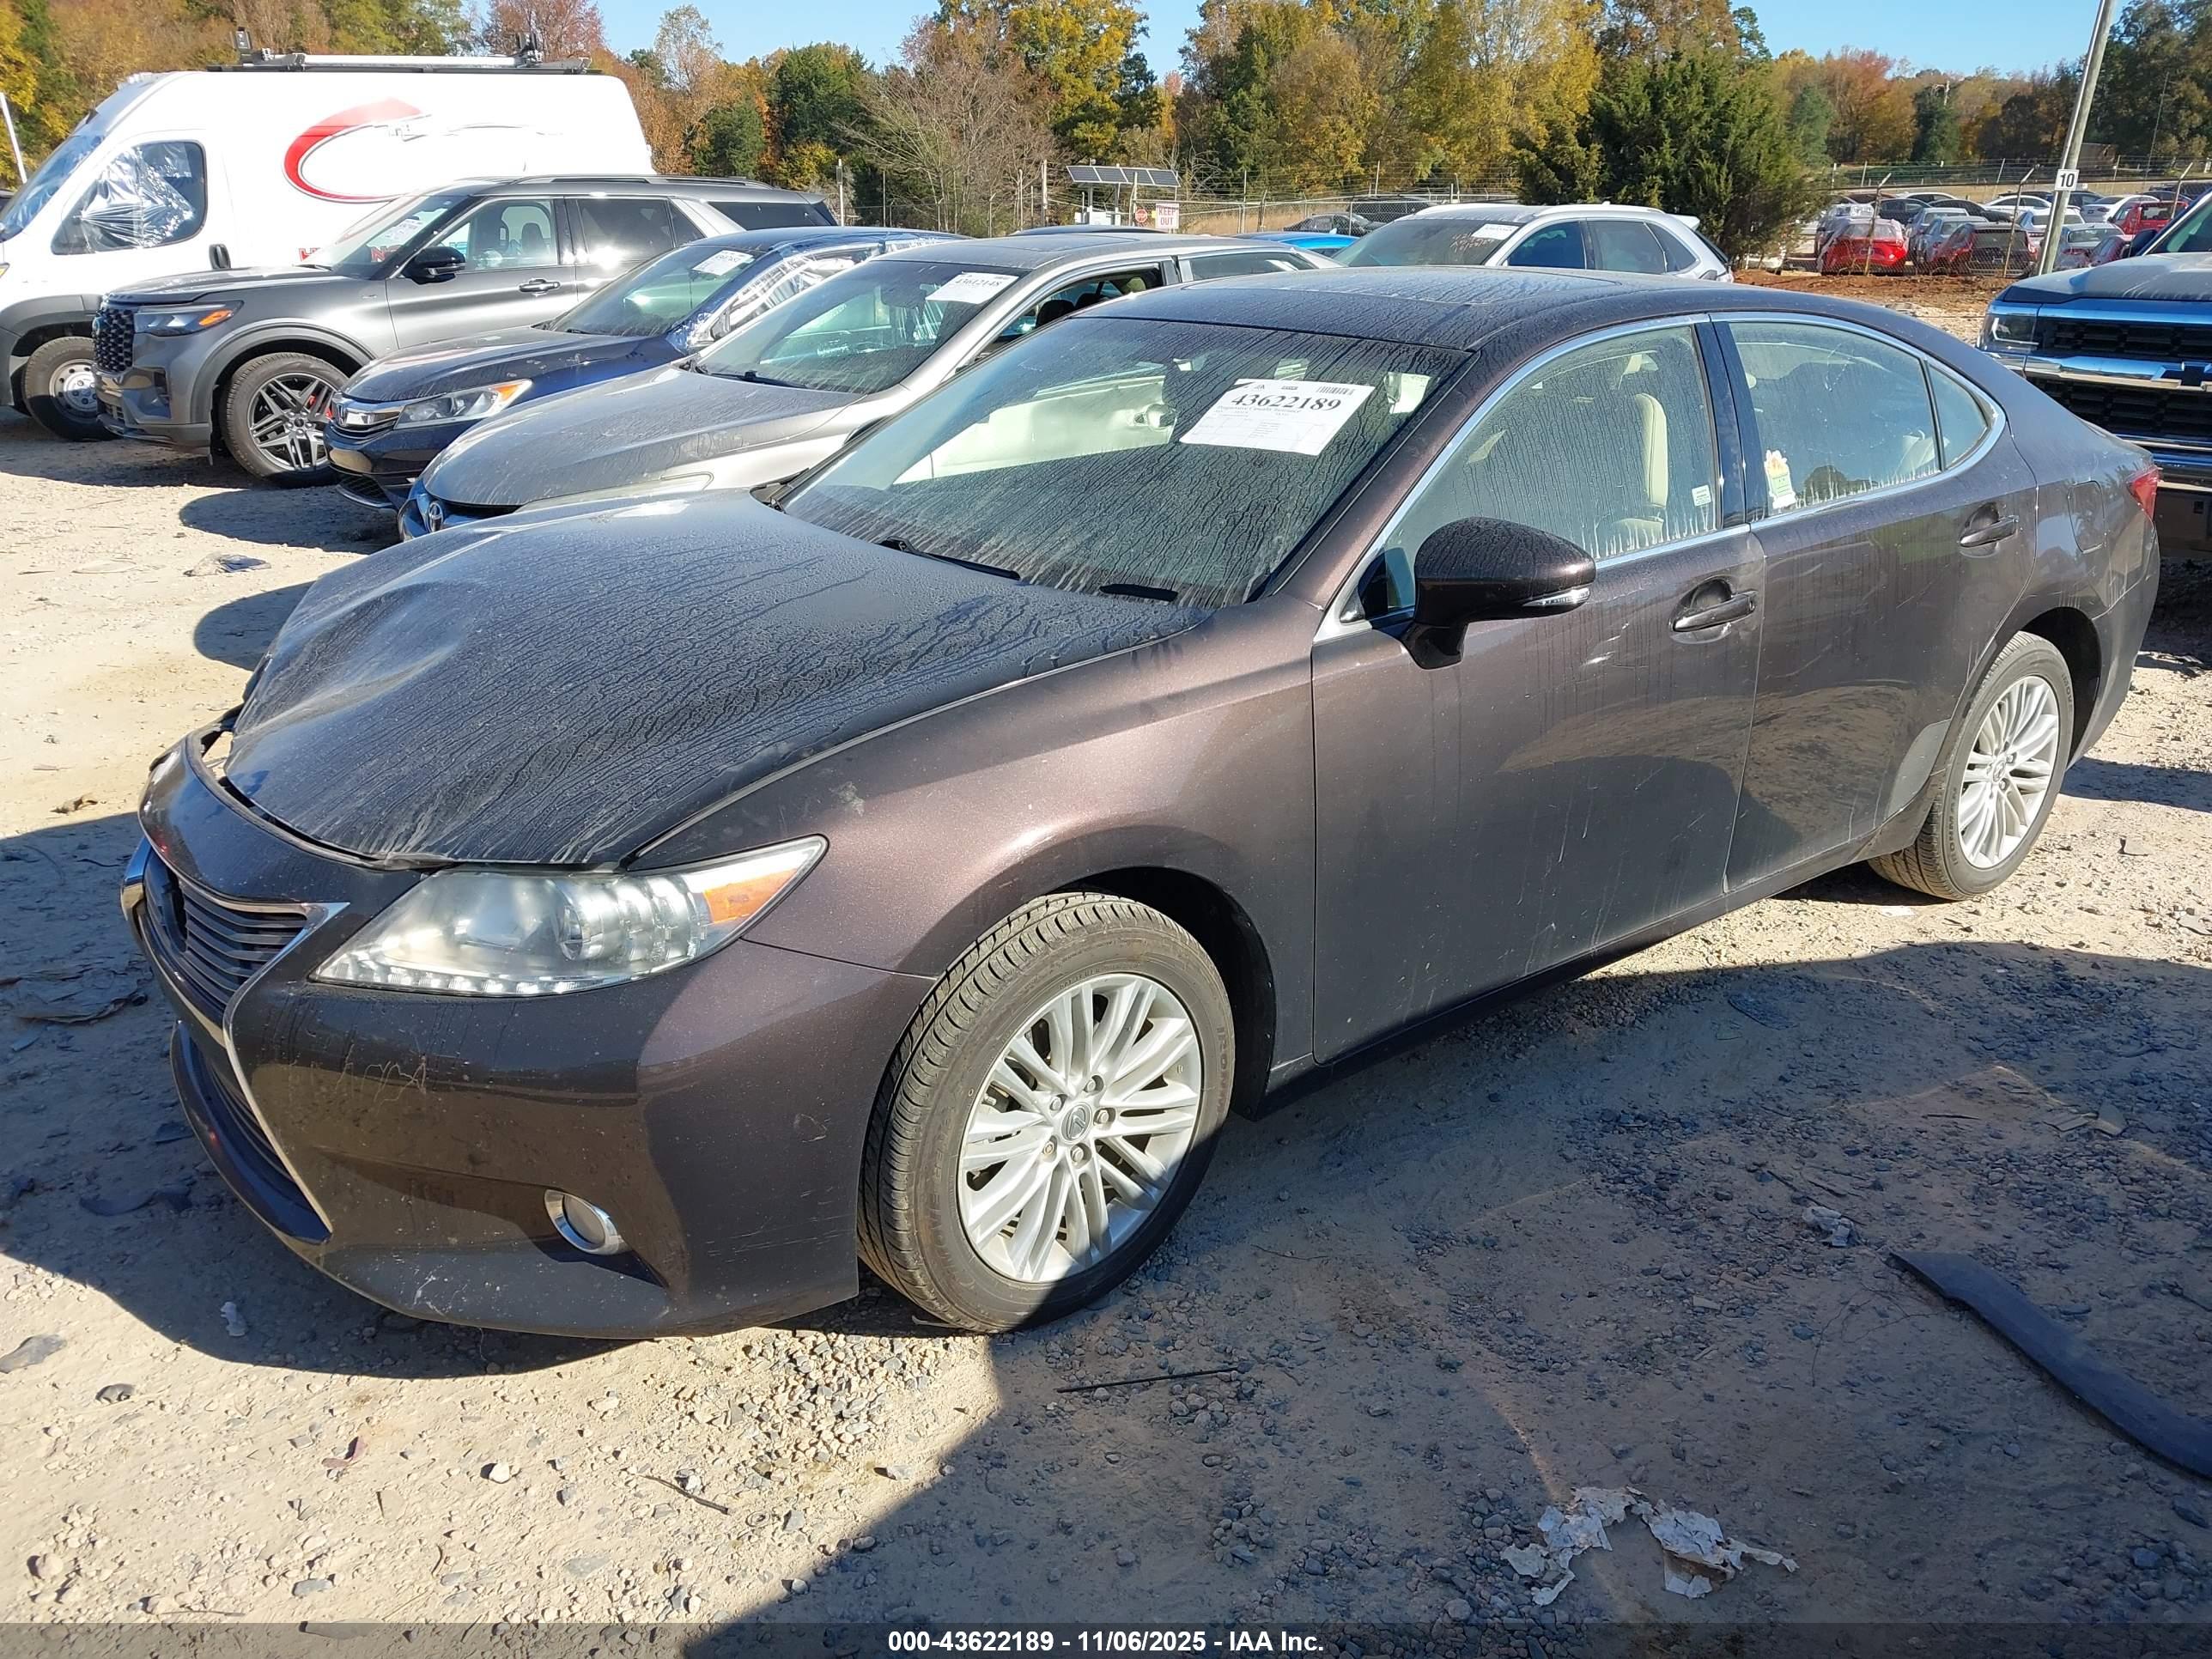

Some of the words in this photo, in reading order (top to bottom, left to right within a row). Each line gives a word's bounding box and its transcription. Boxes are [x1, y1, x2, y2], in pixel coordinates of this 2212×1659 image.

[2060, 173, 2075, 188] 10
[1158, 206, 1176, 216] KEEP
[1160, 216, 1174, 226] OUT
[1231, 393, 1342, 411] 43622189
